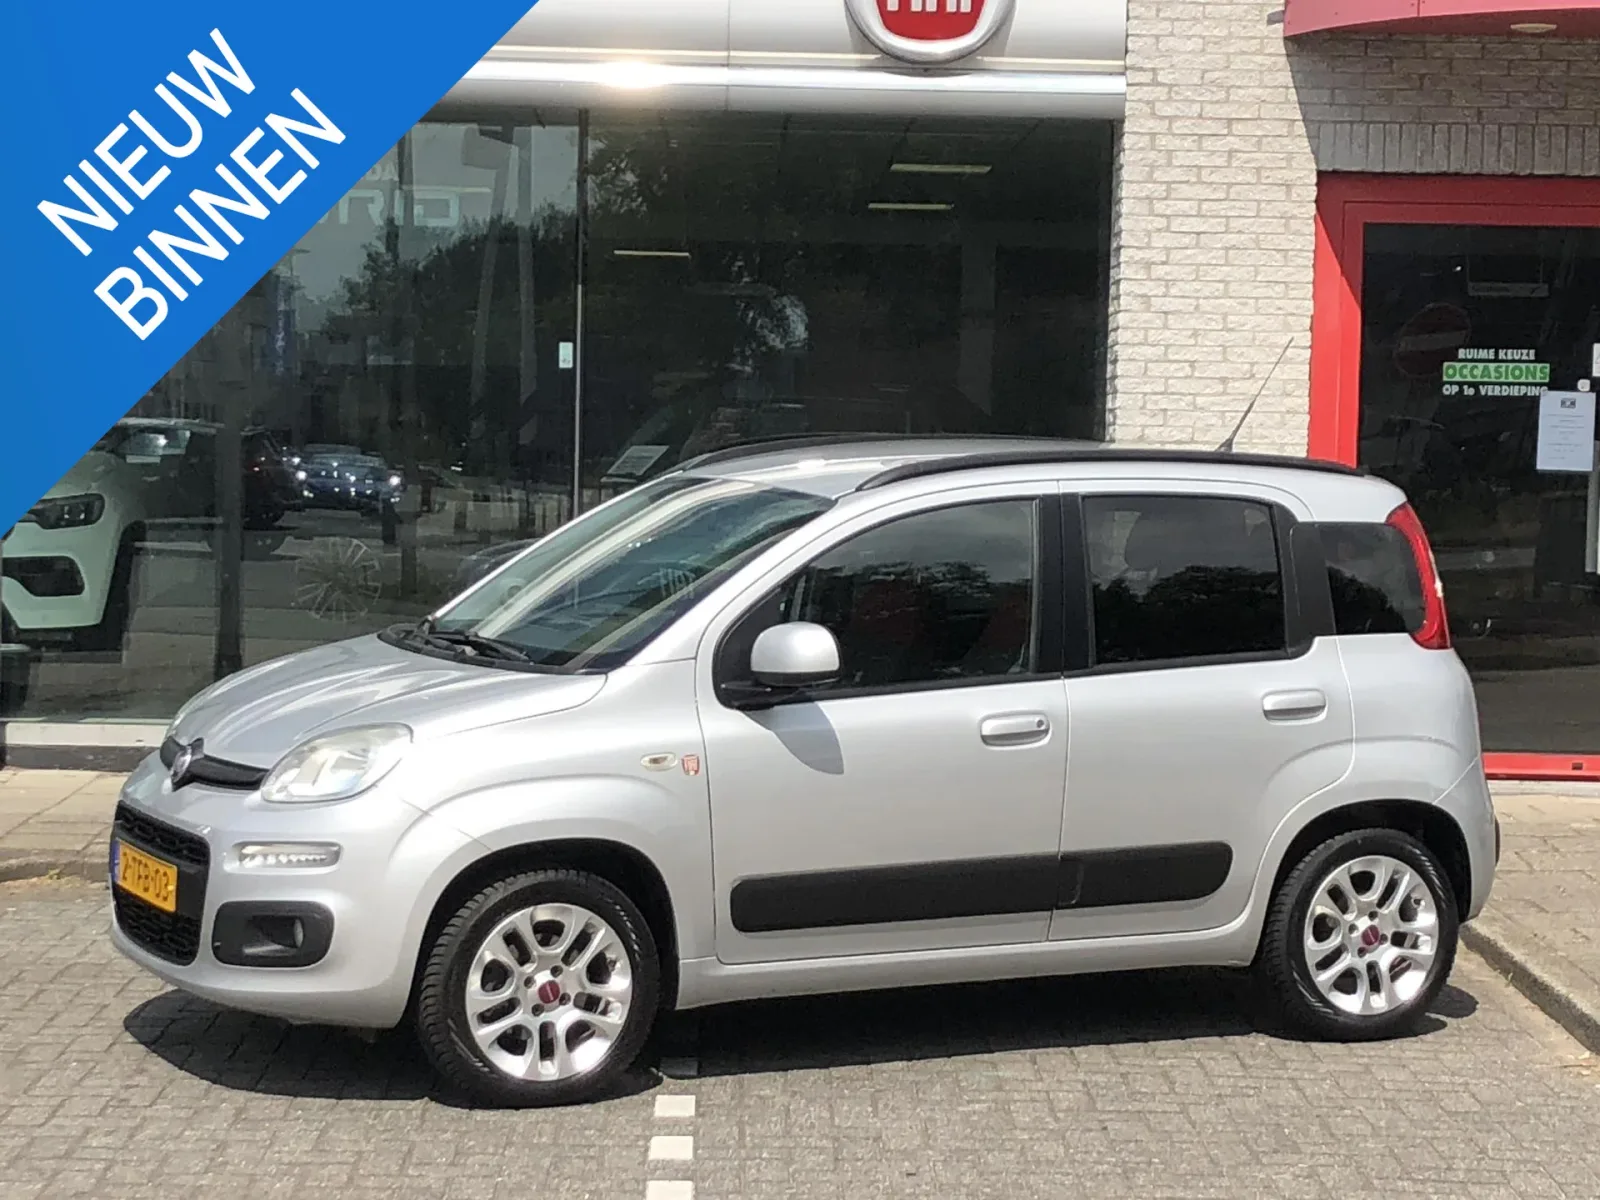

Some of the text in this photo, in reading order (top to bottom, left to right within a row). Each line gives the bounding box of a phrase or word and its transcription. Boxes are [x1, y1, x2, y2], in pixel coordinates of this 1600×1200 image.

[1458, 348, 1535, 360] RUIME KEUZE
[1445, 364, 1548, 380] OCCASIONS
[1442, 384, 1459, 395] OP
